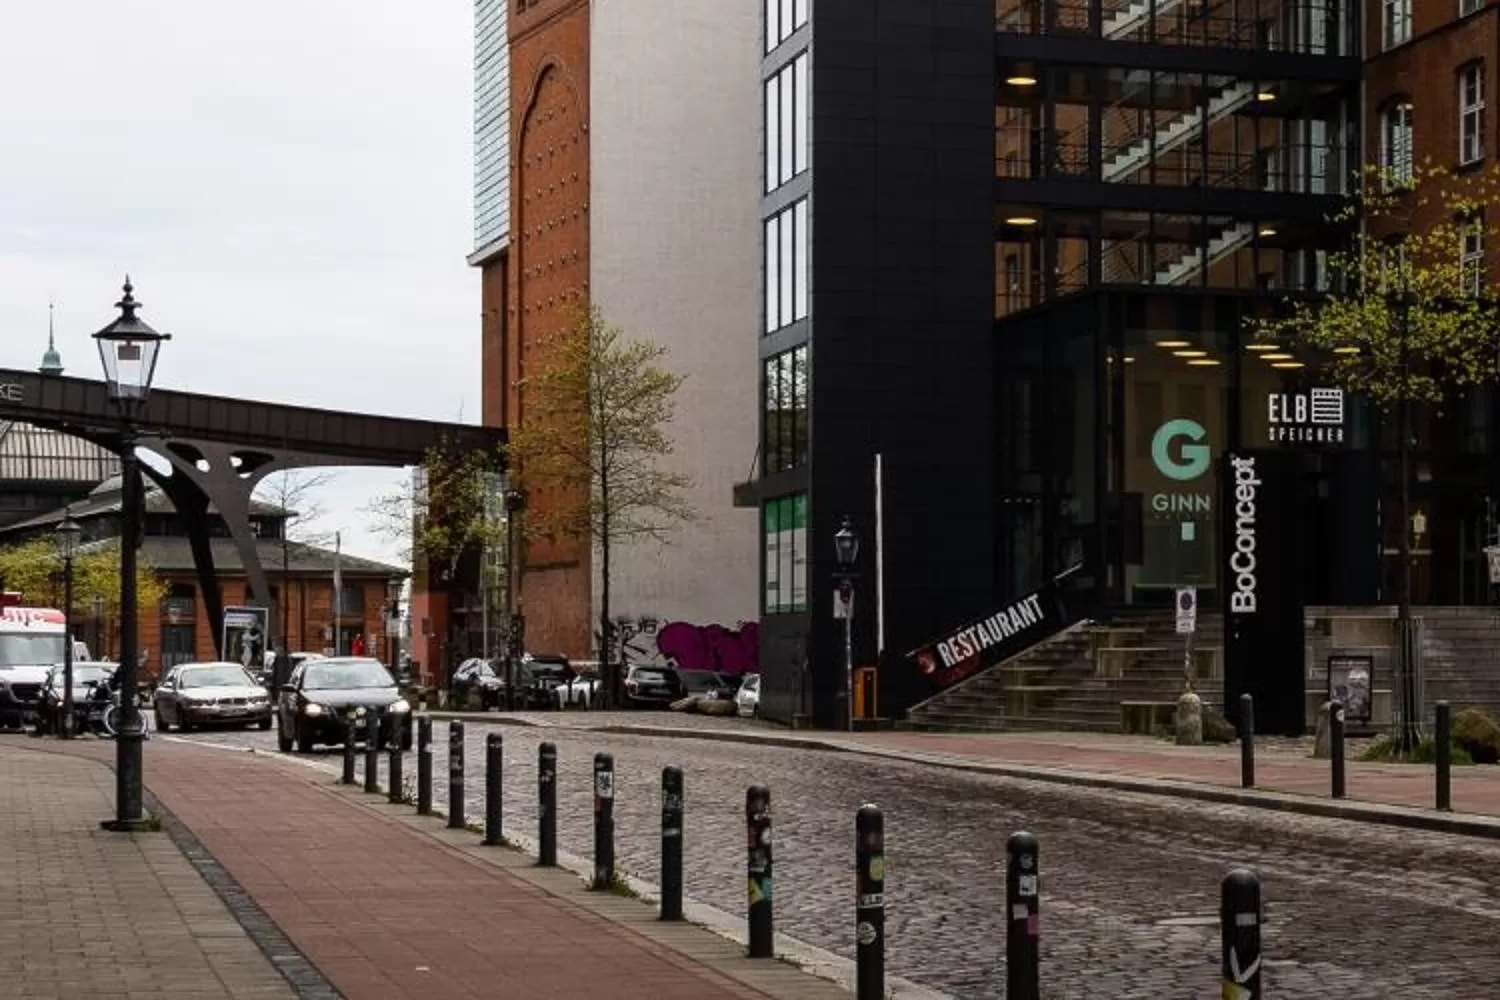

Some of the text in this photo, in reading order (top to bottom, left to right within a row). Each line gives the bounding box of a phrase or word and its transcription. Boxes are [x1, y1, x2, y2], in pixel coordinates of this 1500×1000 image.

[1268, 393, 1307, 423] ELB
[1151, 418, 1211, 481] G
[1268, 426, 1344, 442] SPEICHER
[1151, 493, 1211, 512] GINN
[1230, 456, 1262, 613] BoConcept
[936, 593, 1045, 668] RESTAURANT
